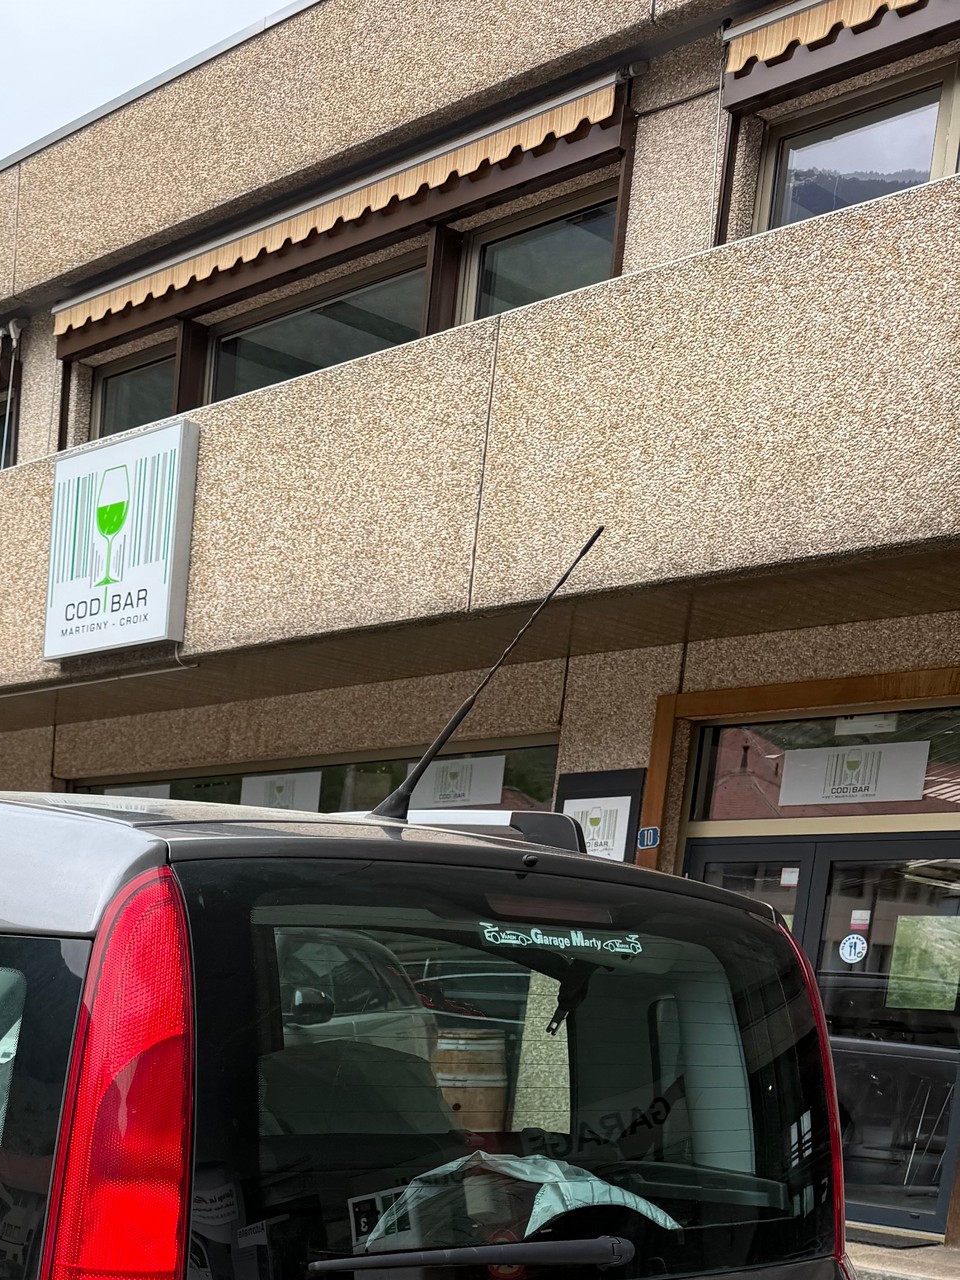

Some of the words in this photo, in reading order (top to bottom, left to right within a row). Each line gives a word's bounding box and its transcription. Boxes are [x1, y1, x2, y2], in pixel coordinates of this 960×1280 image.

[61, 622, 108, 636] MARTIGNY
[120, 613, 148, 627] CROIX
[643, 829, 653, 846] 10
[530, 927, 571, 949] Garage
[570, 930, 602, 950] Marty
